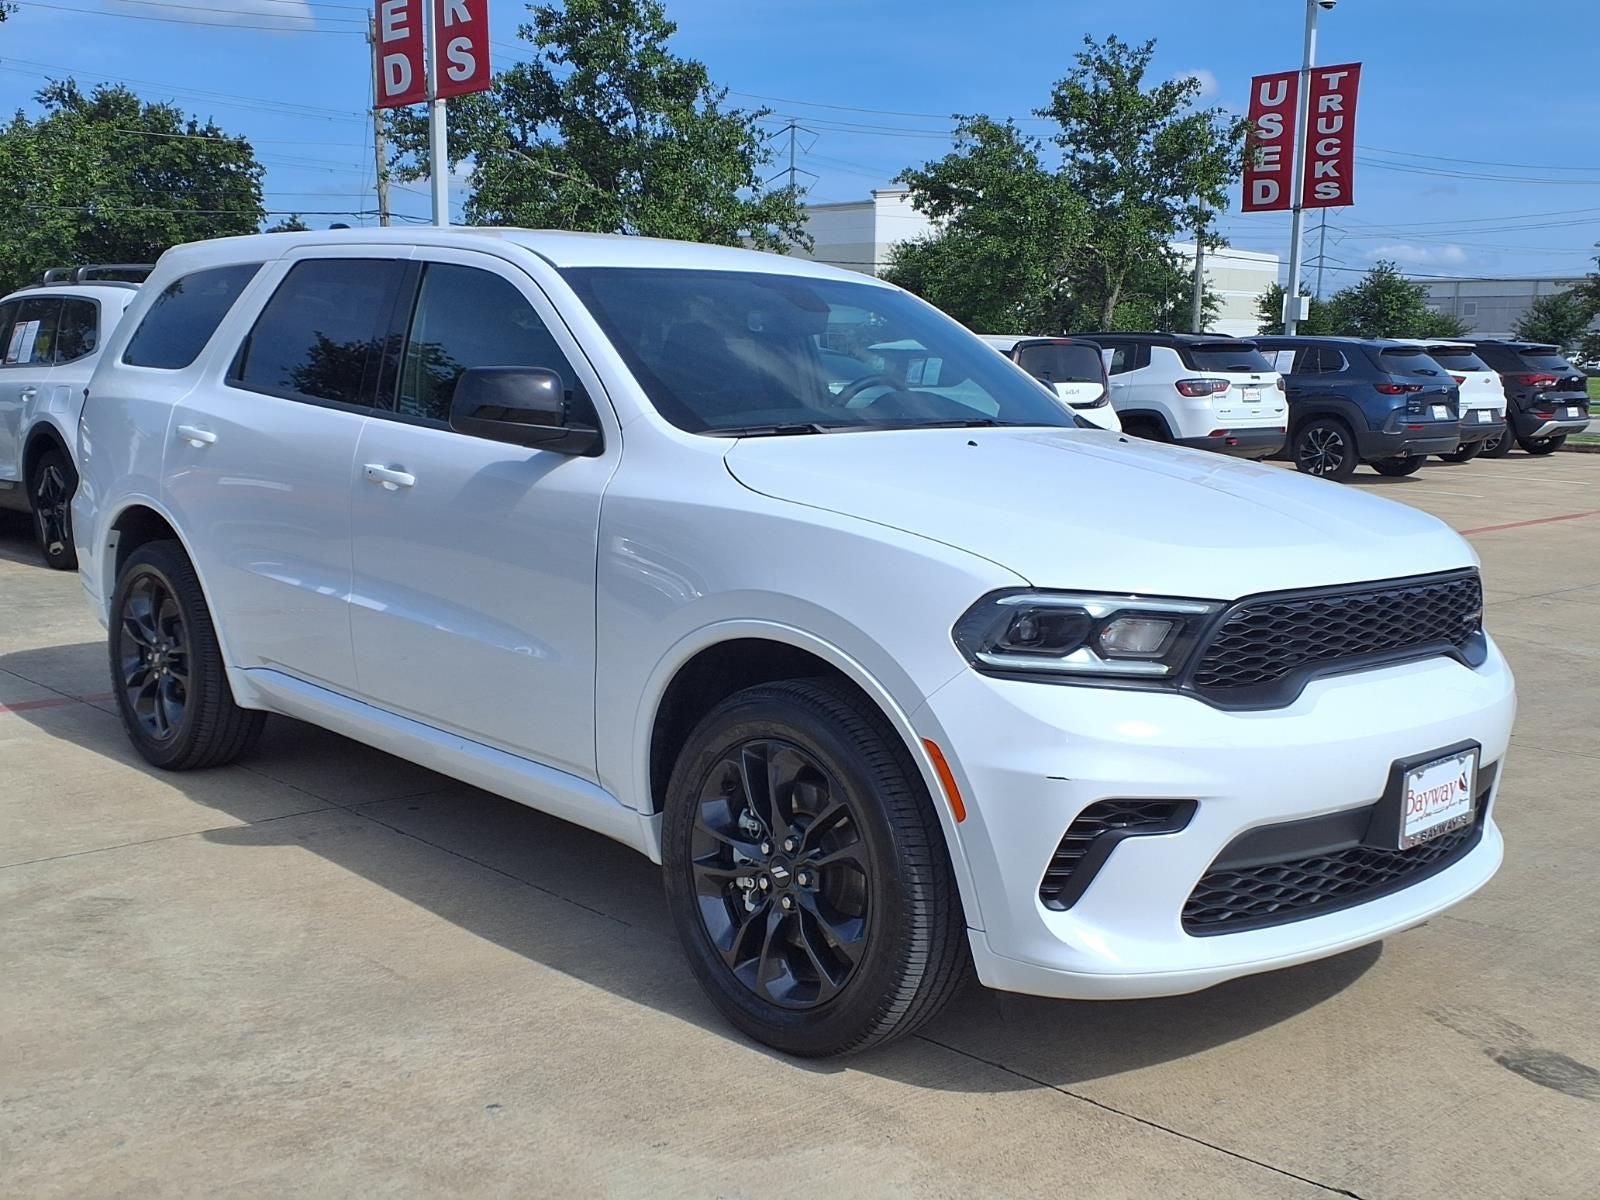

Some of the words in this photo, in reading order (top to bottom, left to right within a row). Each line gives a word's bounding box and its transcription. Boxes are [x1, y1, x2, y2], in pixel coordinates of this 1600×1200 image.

[1252, 79, 1288, 206] USED
[1314, 71, 1348, 200] TRUCKS
[1406, 780, 1458, 816] Bayway
